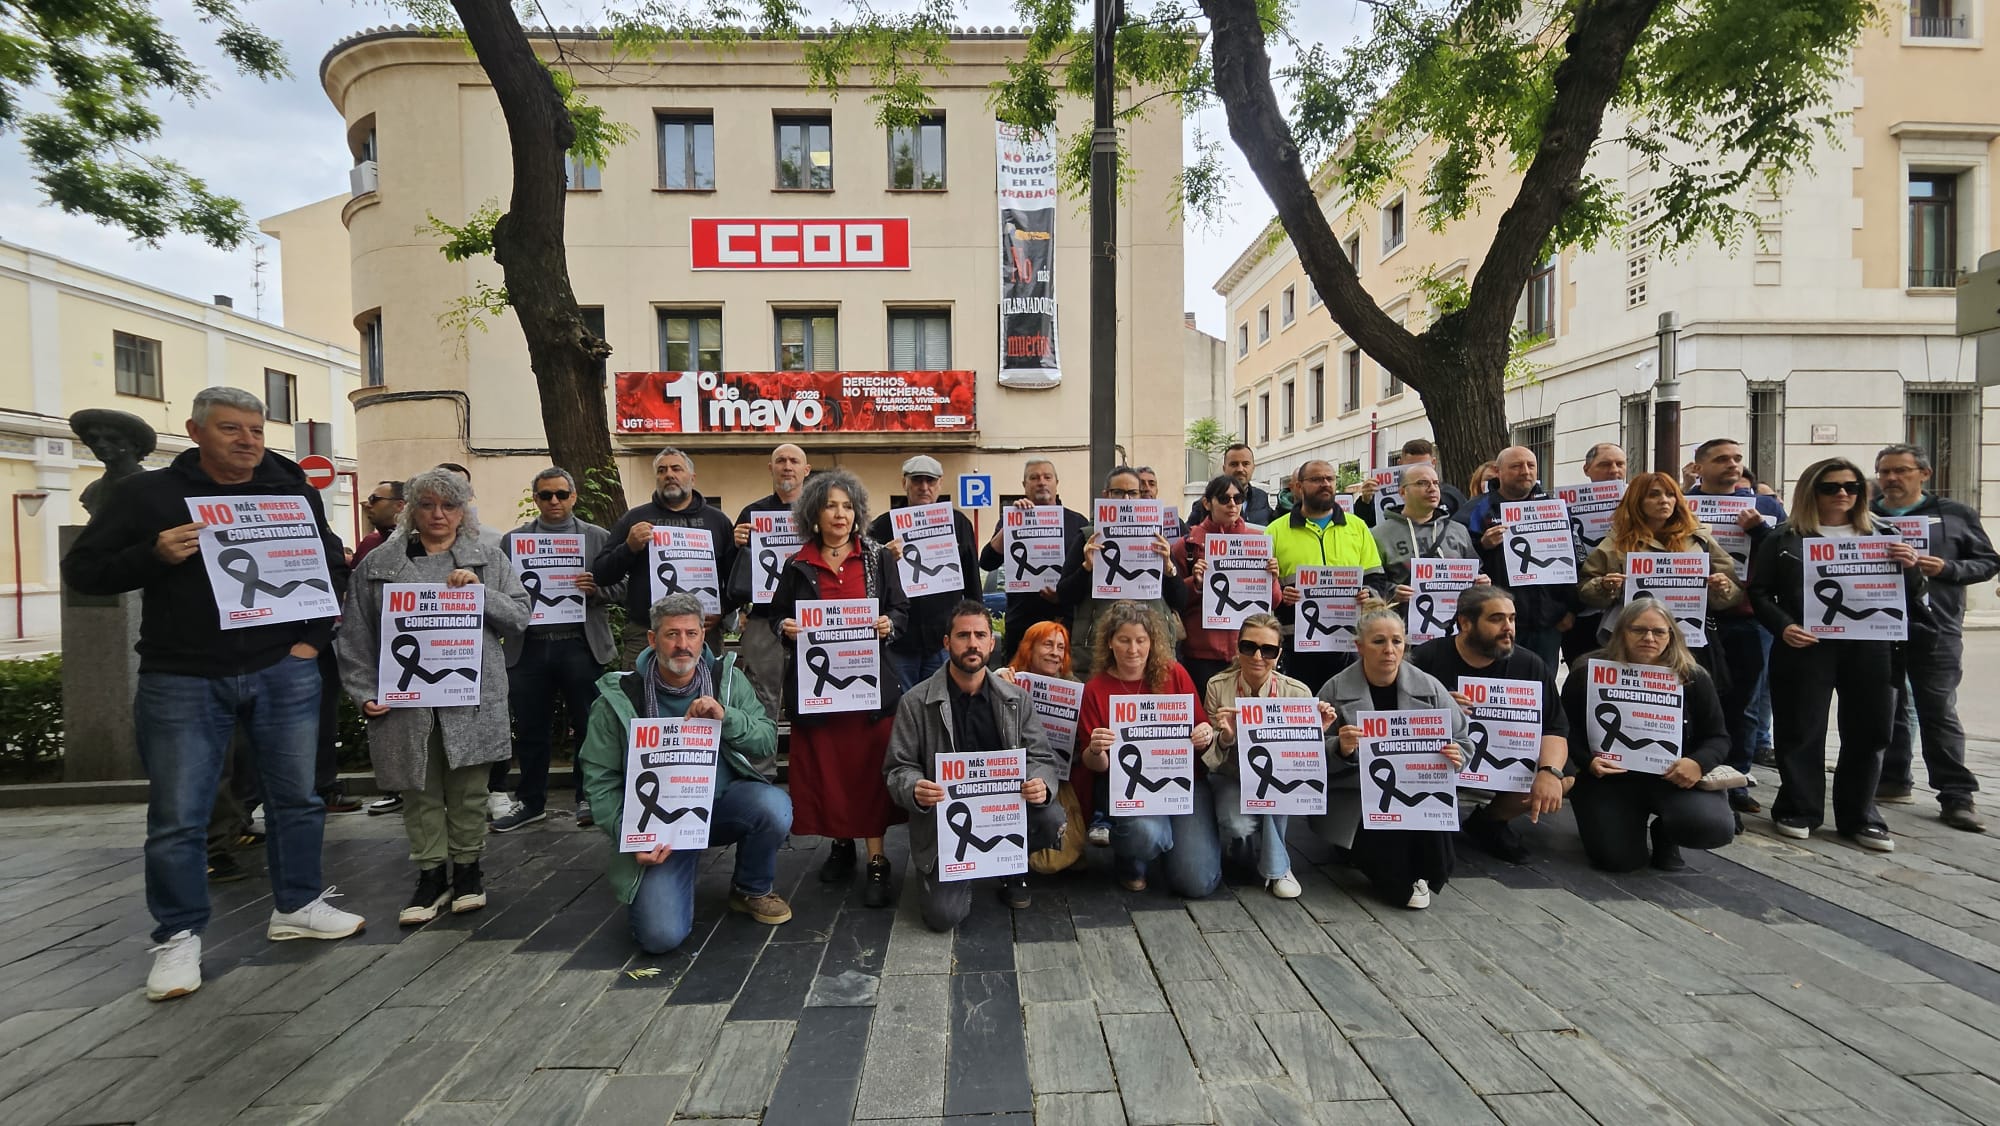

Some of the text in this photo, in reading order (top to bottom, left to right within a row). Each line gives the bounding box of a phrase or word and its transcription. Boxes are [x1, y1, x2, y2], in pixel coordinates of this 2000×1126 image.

[1004, 152, 1022, 162] NO
[1001, 164, 1054, 175] MUERTOS
[1000, 188, 1055, 198] TRABAJO
[718, 224, 884, 262] CCOO
[1010, 246, 1032, 282] No
[1007, 331, 1050, 356] muertos
[842, 377, 908, 388] DERECHOS,
[714, 384, 740, 400] de
[795, 390, 820, 400] 2026
[842, 387, 937, 396] NO TRINCHERAS.
[622, 418, 644, 428] UGT
[709, 399, 823, 432] mayo
[967, 480, 985, 504] P
[198, 501, 301, 525] NO MÁS MUERTES
[238, 512, 307, 522] EN EL TRABAJO
[895, 512, 912, 529] NO
[1007, 511, 1022, 526] NO
[1099, 505, 1116, 522] NO
[1504, 507, 1522, 522] NO
[224, 524, 314, 540] CONCENTRACIÓN
[755, 517, 772, 533] NO
[652, 531, 671, 546] NO
[516, 539, 535, 554] NO
[1210, 539, 1227, 556] NO
[1809, 543, 1835, 561] NO
[1416, 564, 1432, 578] NO
[1632, 558, 1652, 574] NO
[1825, 562, 1898, 573] CONCENTRACIÓN
[1300, 570, 1317, 585] NO
[1643, 576, 1704, 586] CONCENTRACIÓN
[390, 591, 473, 612] NO MÁS MUERTES
[441, 603, 474, 611] TRABAJO
[404, 615, 477, 627] CONCENTRACIÓN
[801, 605, 871, 627] NO MÁS MUERTES
[836, 617, 843, 625] EL
[845, 616, 872, 625] TRABAJO
[814, 627, 874, 641] CONCENTRACIÓN
[1594, 665, 1674, 685] NO MÁS MUERTES
[1464, 683, 1536, 703] NO MÁS MUERTES
[1643, 680, 1676, 691] TRABAJO
[1499, 696, 1506, 704] EL
[1509, 697, 1537, 707] TRABAJO
[1607, 687, 1678, 705] CONCENTRACIÓN
[1115, 701, 1186, 722] NO MÁS MUERTES
[1140, 713, 1148, 721] EN
[1159, 713, 1187, 721] TRABAJO
[1241, 704, 1312, 724] NO MÁS MUERTES
[1476, 706, 1538, 721] CONCENTRACIÓN
[1286, 716, 1315, 724] TRABAJO
[1363, 716, 1442, 737] NO MÁS MUERTES
[636, 725, 712, 747] NO MÁS MUERTES
[1128, 725, 1189, 737] CONCENTRACIÓN
[1255, 727, 1318, 739] CONCENTRACIÓN
[1390, 728, 1400, 736] EN
[1412, 727, 1445, 736] TRABAJO
[662, 738, 670, 746] EN
[682, 737, 712, 746] TRABAJO
[648, 750, 713, 763] CONCENTRACIÓN
[942, 756, 1017, 781] NO MÁS MUERTES
[968, 767, 1019, 778] EN EL TRABAJO
[956, 779, 1020, 794] CONCENTRACIÓN
